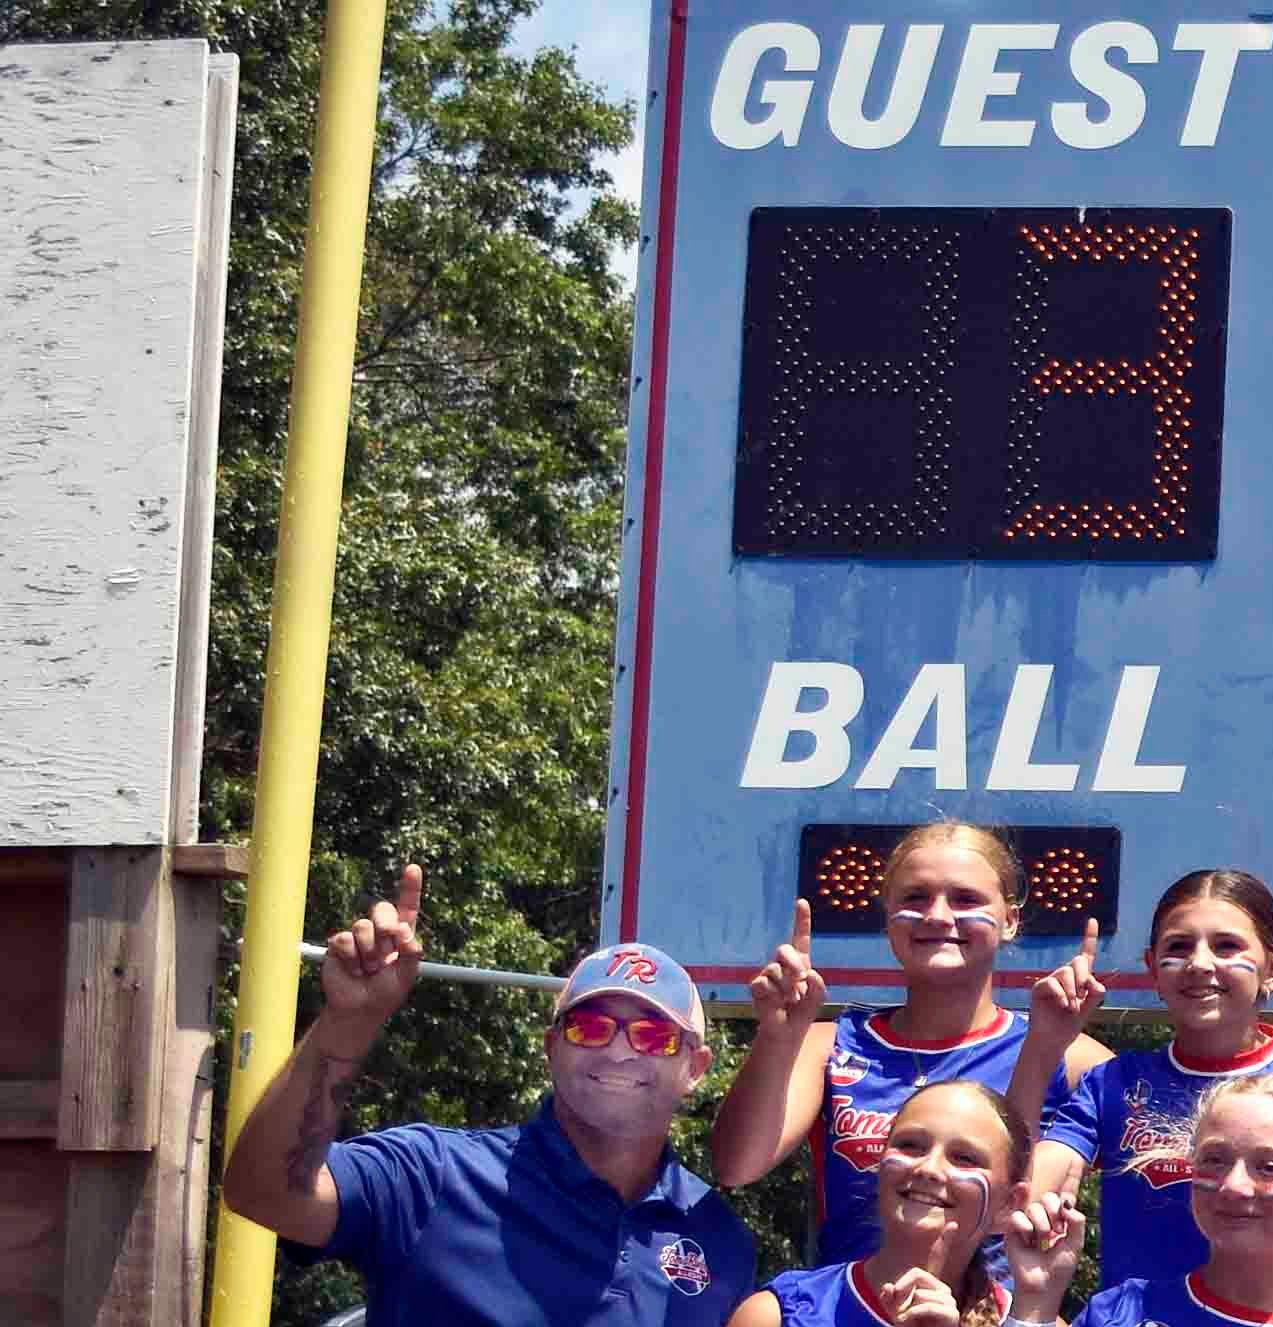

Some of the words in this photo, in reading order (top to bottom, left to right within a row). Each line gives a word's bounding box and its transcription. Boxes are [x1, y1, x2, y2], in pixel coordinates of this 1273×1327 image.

[1003, 224, 1202, 541] 3
[740, 661, 1186, 793] BALL
[606, 949, 658, 984] TR
